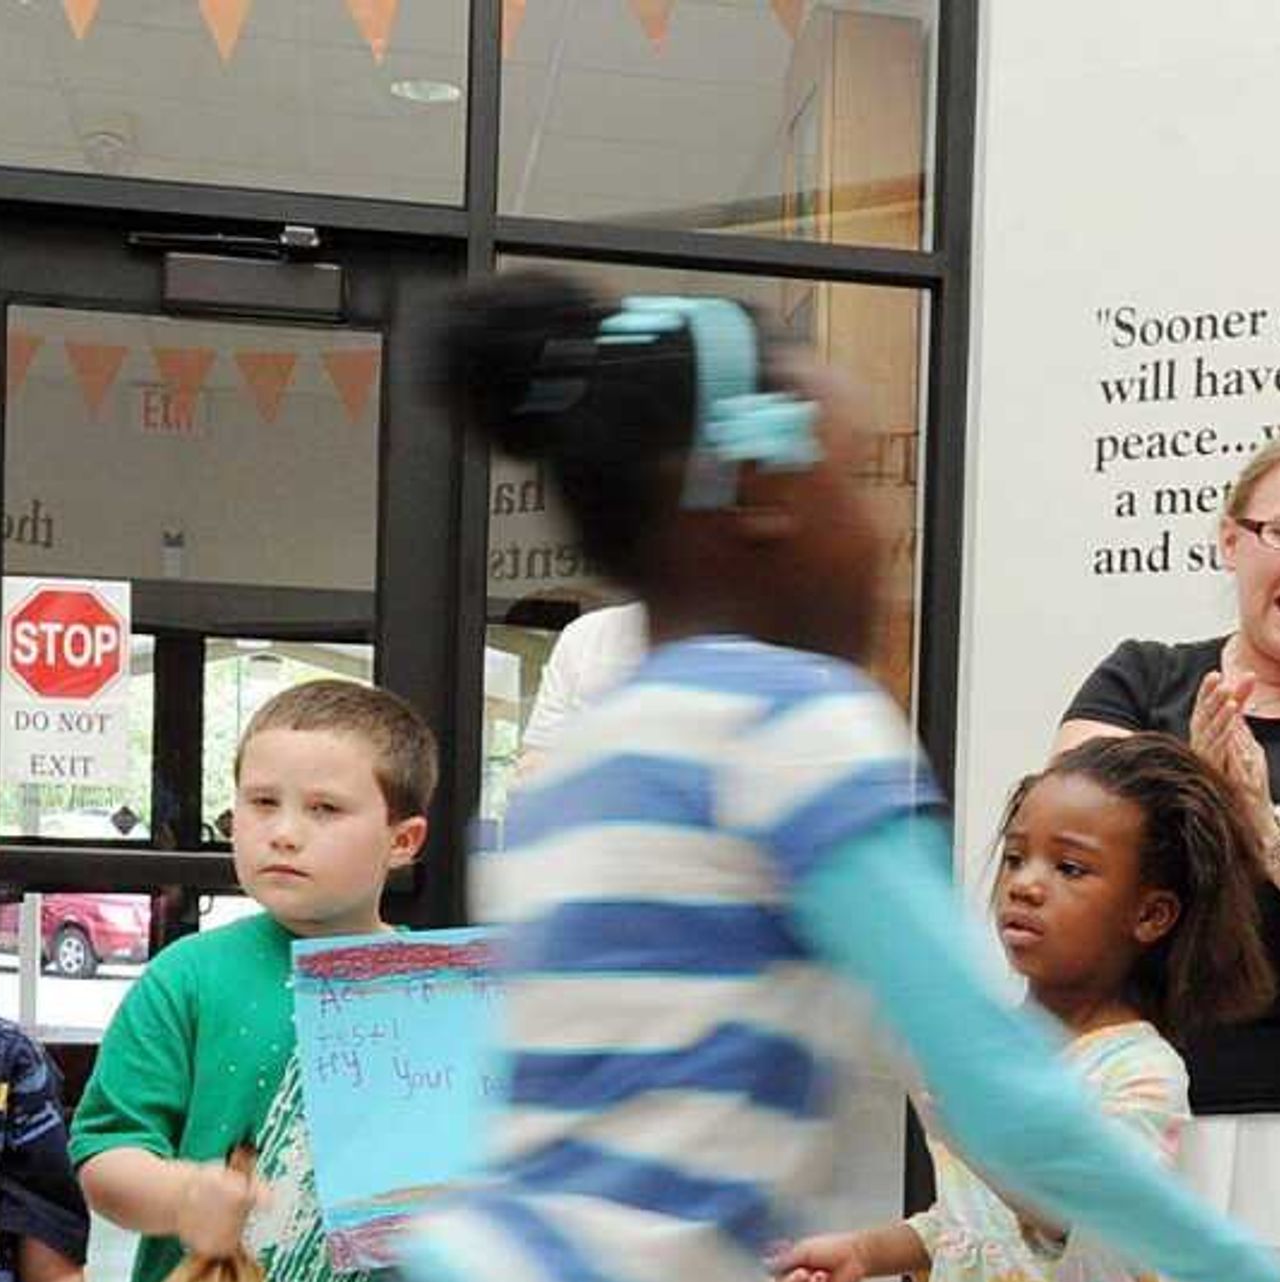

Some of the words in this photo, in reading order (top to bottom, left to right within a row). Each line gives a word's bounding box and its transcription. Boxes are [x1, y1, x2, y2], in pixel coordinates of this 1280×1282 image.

[1096, 305, 1268, 349] "Sooner
[1100, 359, 1177, 404] will
[1115, 488, 1137, 518] a
[1093, 530, 1171, 575] and
[12, 624, 120, 668] STOP
[15, 711, 50, 732] DO
[57, 713, 112, 734] NOT
[30, 754, 94, 777] EXIT
